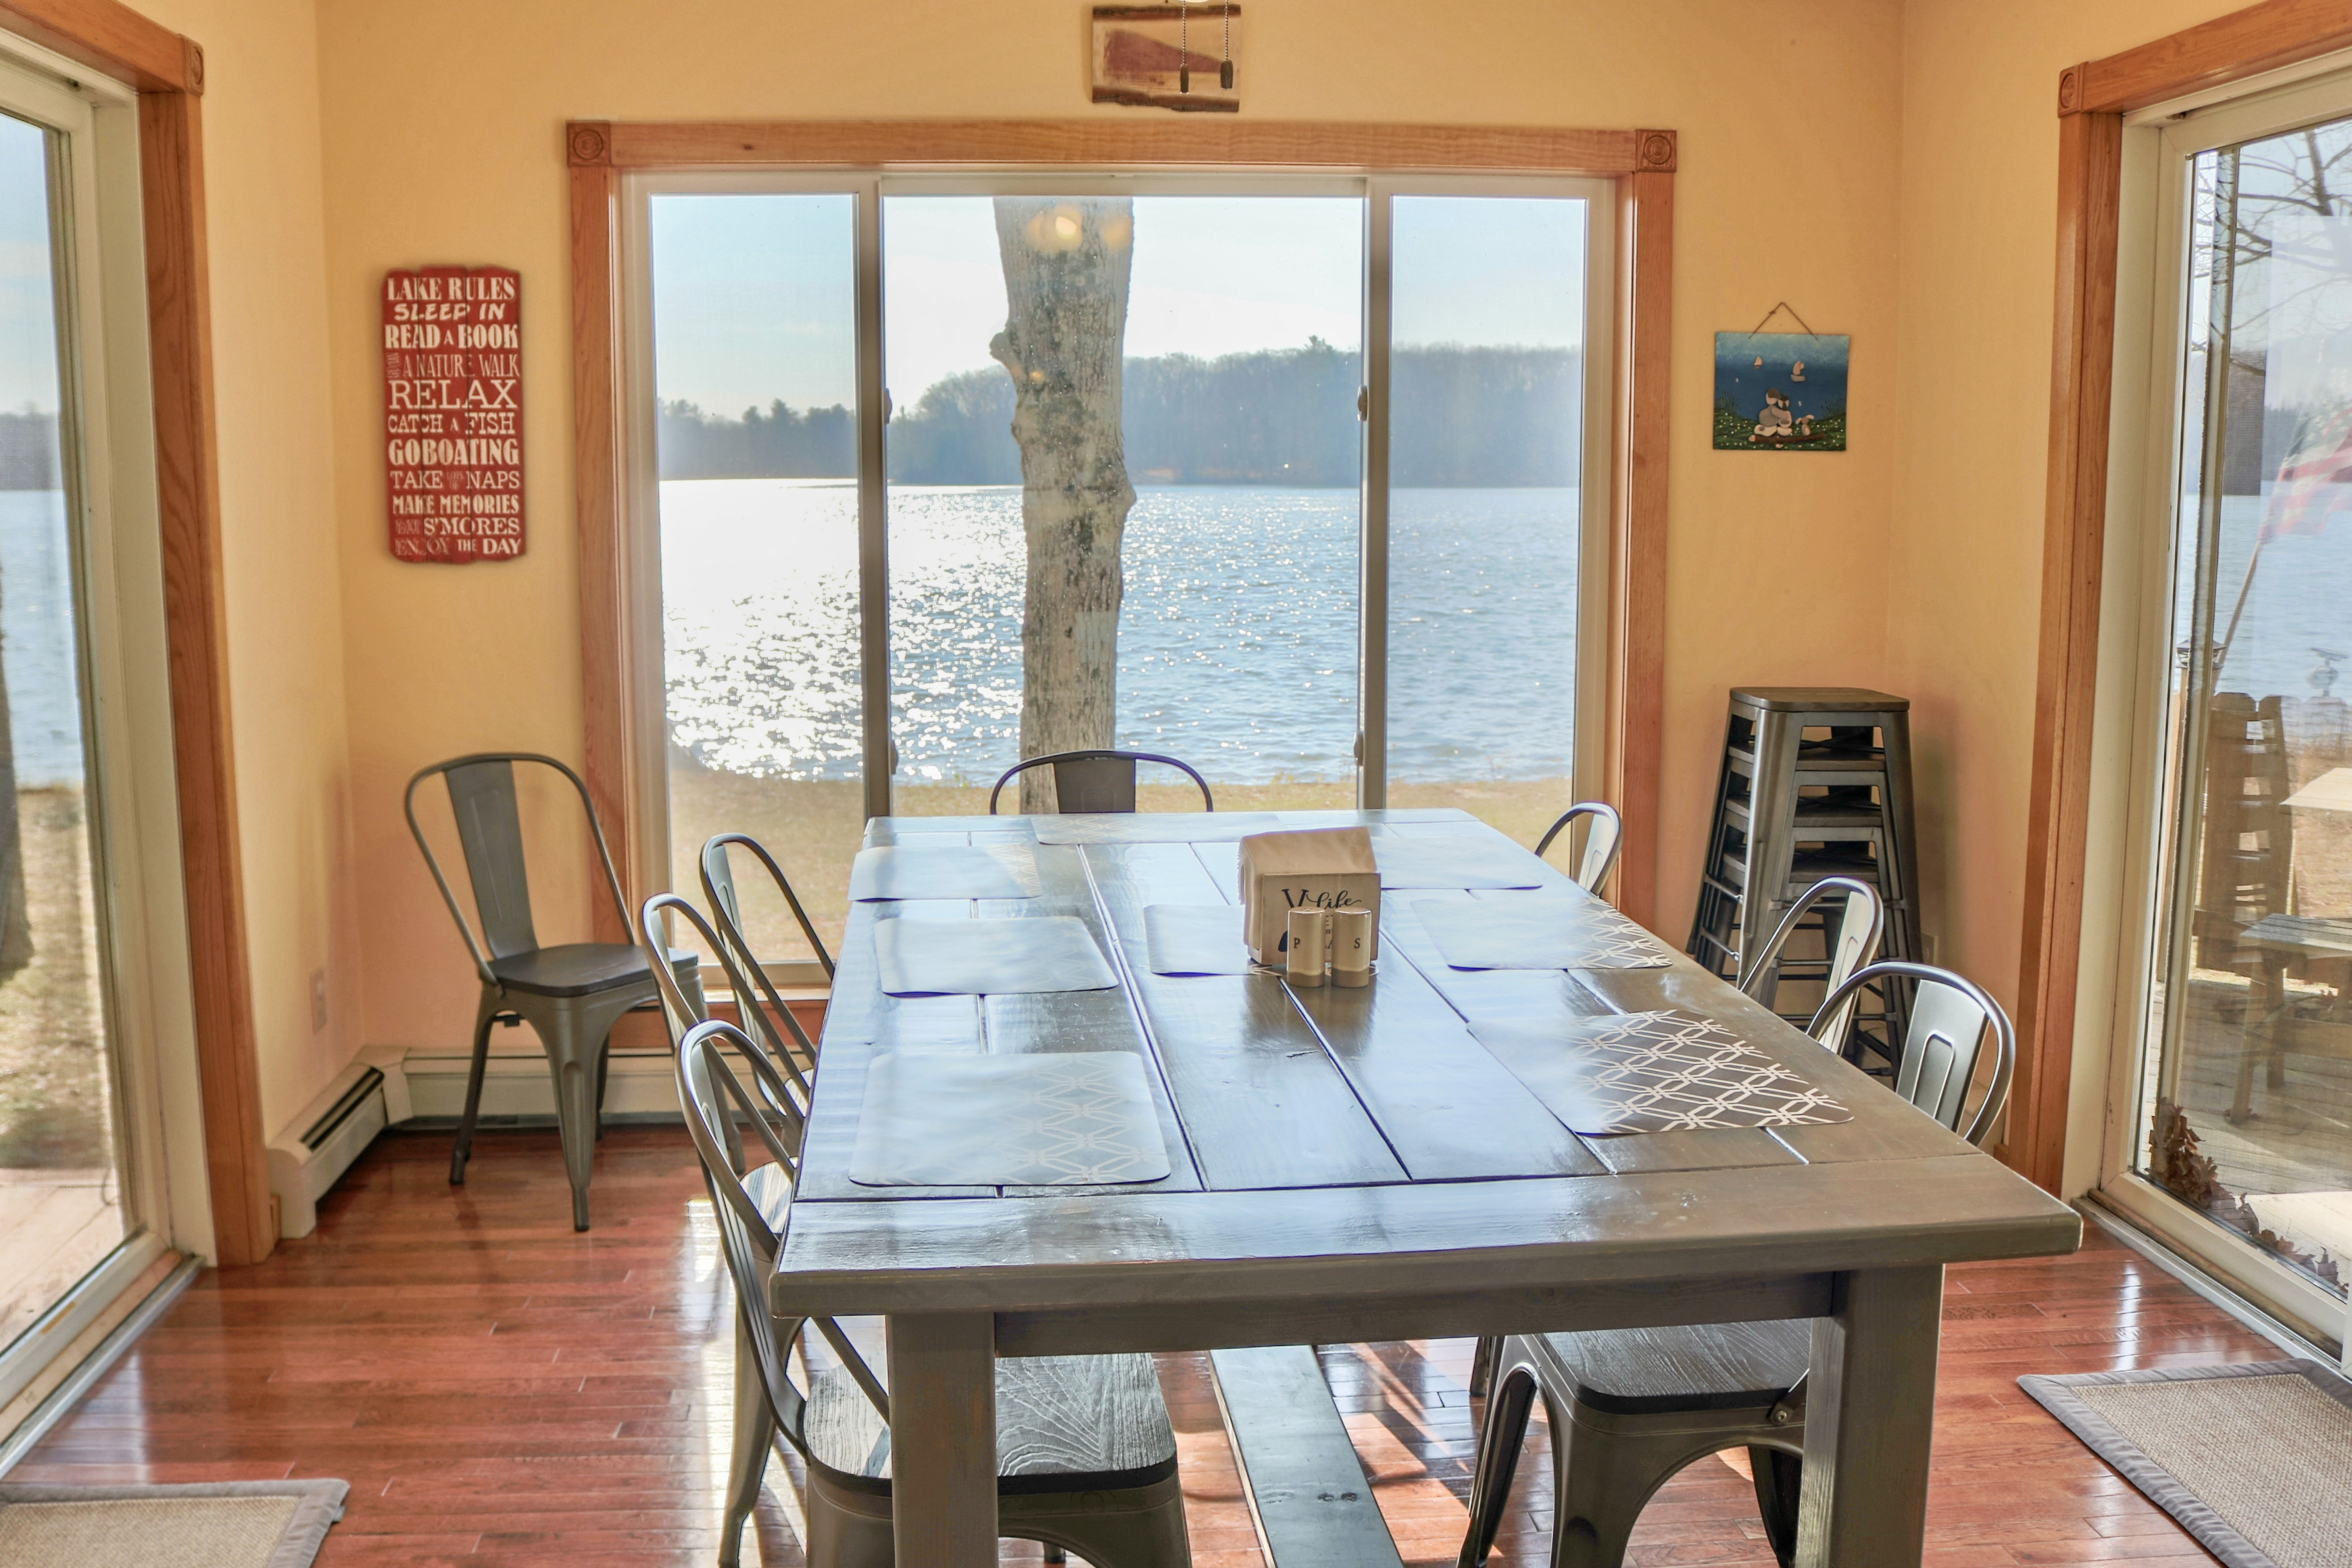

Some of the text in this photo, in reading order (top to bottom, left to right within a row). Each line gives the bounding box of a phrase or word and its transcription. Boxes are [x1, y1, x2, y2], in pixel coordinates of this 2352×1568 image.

[387, 277, 515, 300] LAKE RULES
[394, 303, 505, 321] SLEEP IN
[384, 324, 518, 349] READ A BOOK
[403, 354, 413, 378] A
[417, 354, 476, 378] NATURE
[478, 354, 520, 378] WALK
[388, 379, 517, 409] RELAX
[388, 412, 515, 435] CATCH A FISH
[390, 470, 443, 489] TAKE
[466, 470, 520, 490] NAPS
[393, 494, 519, 515] MAKE MEMORIES
[395, 517, 520, 536] EAT S'MORES
[395, 537, 521, 555] ENJOY THE DAY
[1293, 938, 1301, 949] P
[1354, 938, 1360, 949] S
